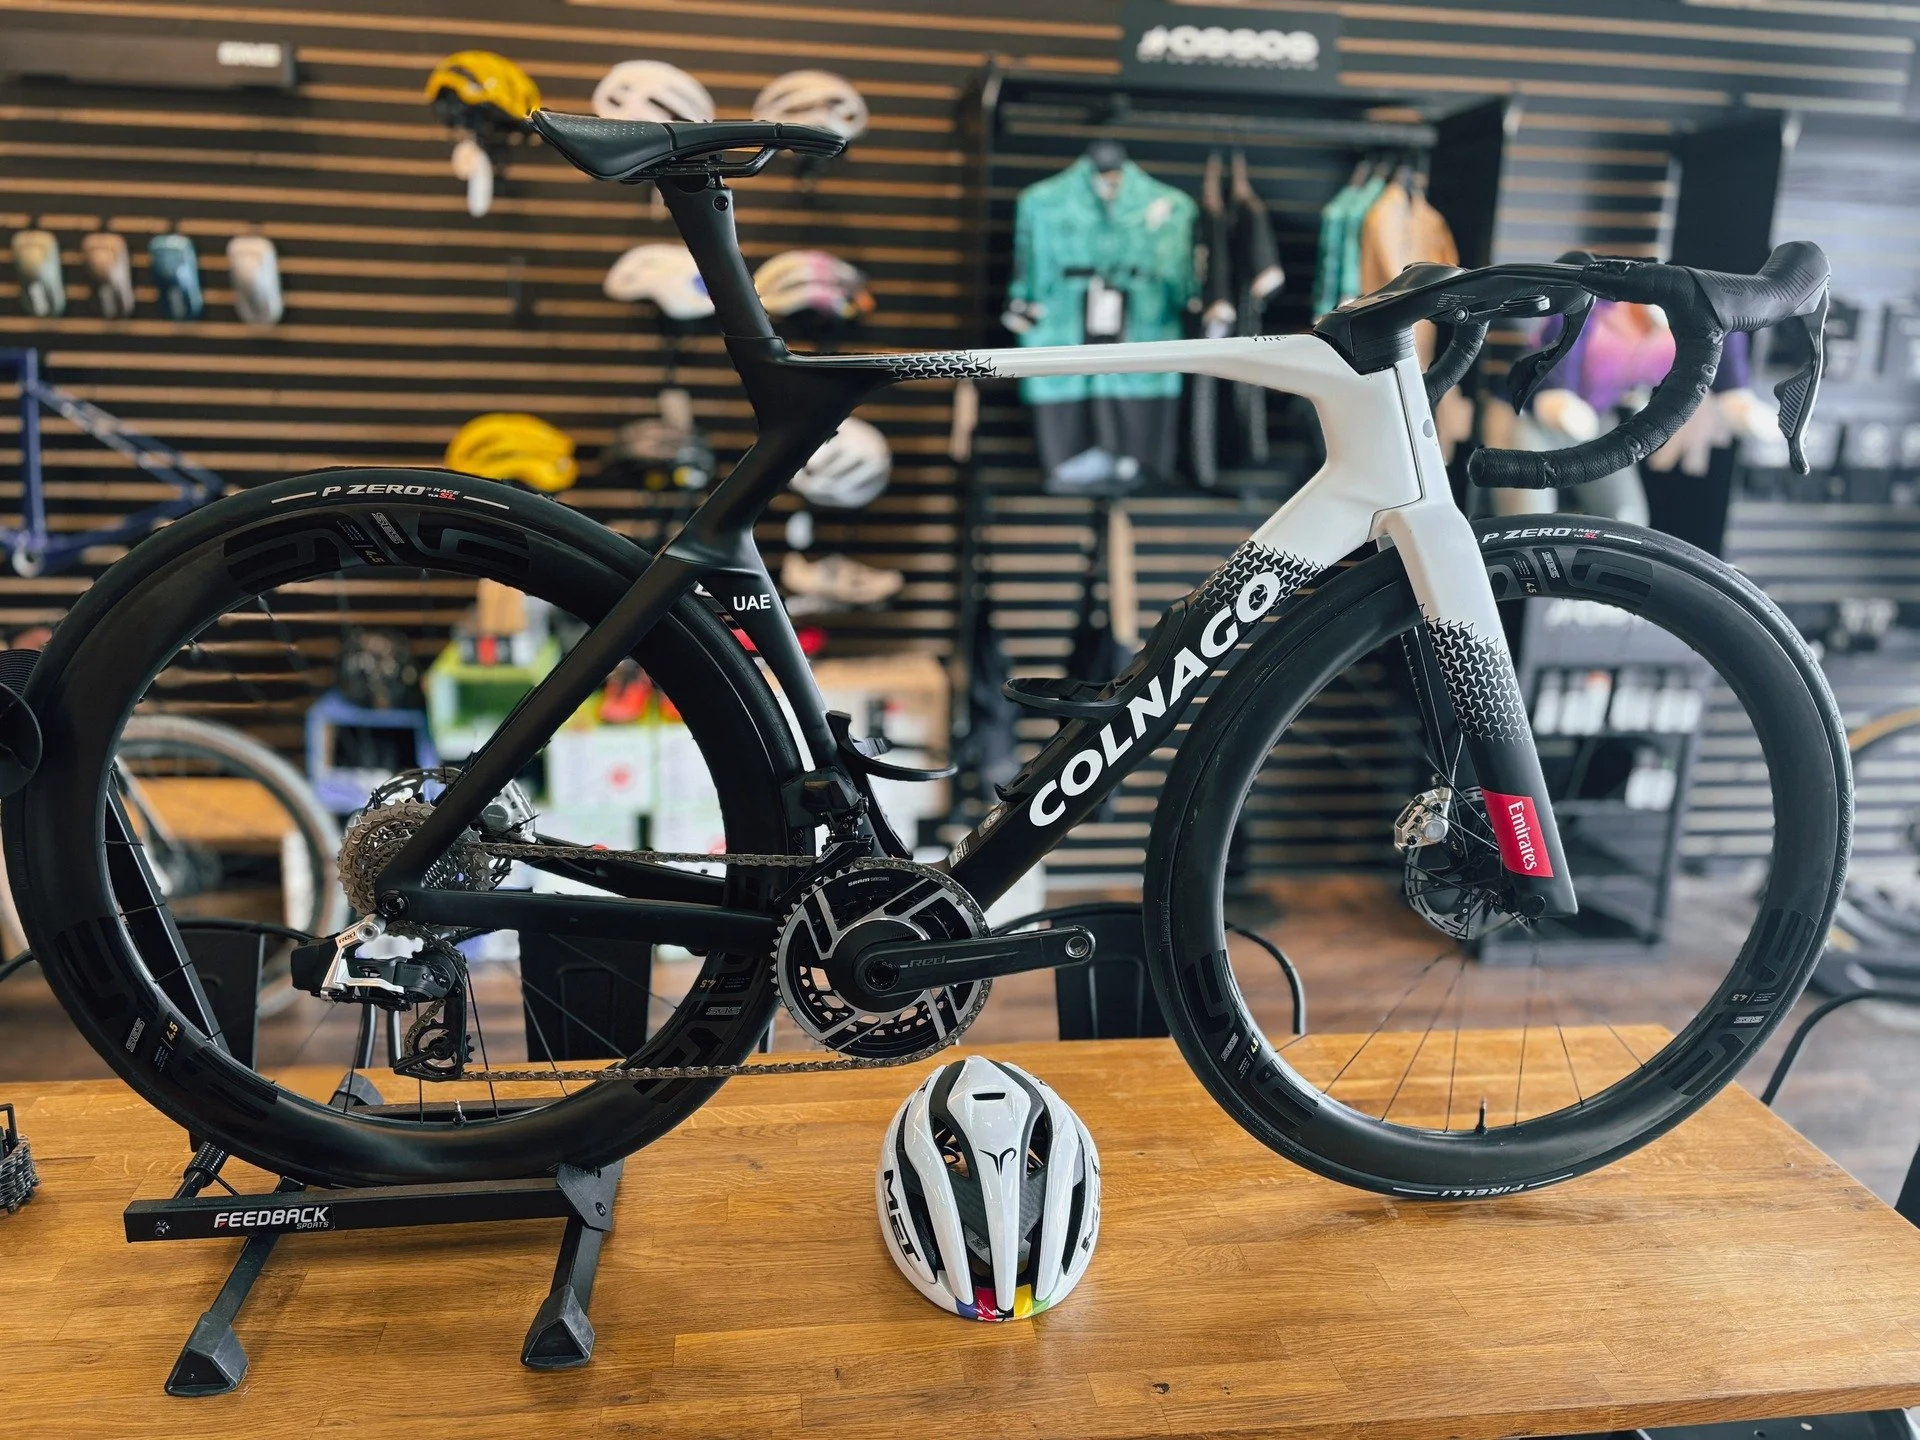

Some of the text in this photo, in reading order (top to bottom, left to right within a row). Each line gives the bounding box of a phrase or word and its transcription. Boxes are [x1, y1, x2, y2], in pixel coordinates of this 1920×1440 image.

[321, 485, 342, 498] P
[346, 483, 427, 496] ZERO
[439, 492, 456, 501] SL
[1481, 532, 1500, 544] P
[1502, 527, 1573, 540] ZERO
[733, 593, 772, 611] UAE
[1028, 571, 1281, 828] COLNAGO
[1507, 800, 1538, 871] Emirates
[166, 1020, 179, 1041] 4.5
[1440, 1183, 1525, 1197] PIRELLI
[213, 1206, 330, 1229] FEEDBACK
[883, 1169, 922, 1262] MET
[296, 1220, 330, 1230] SPORTS
